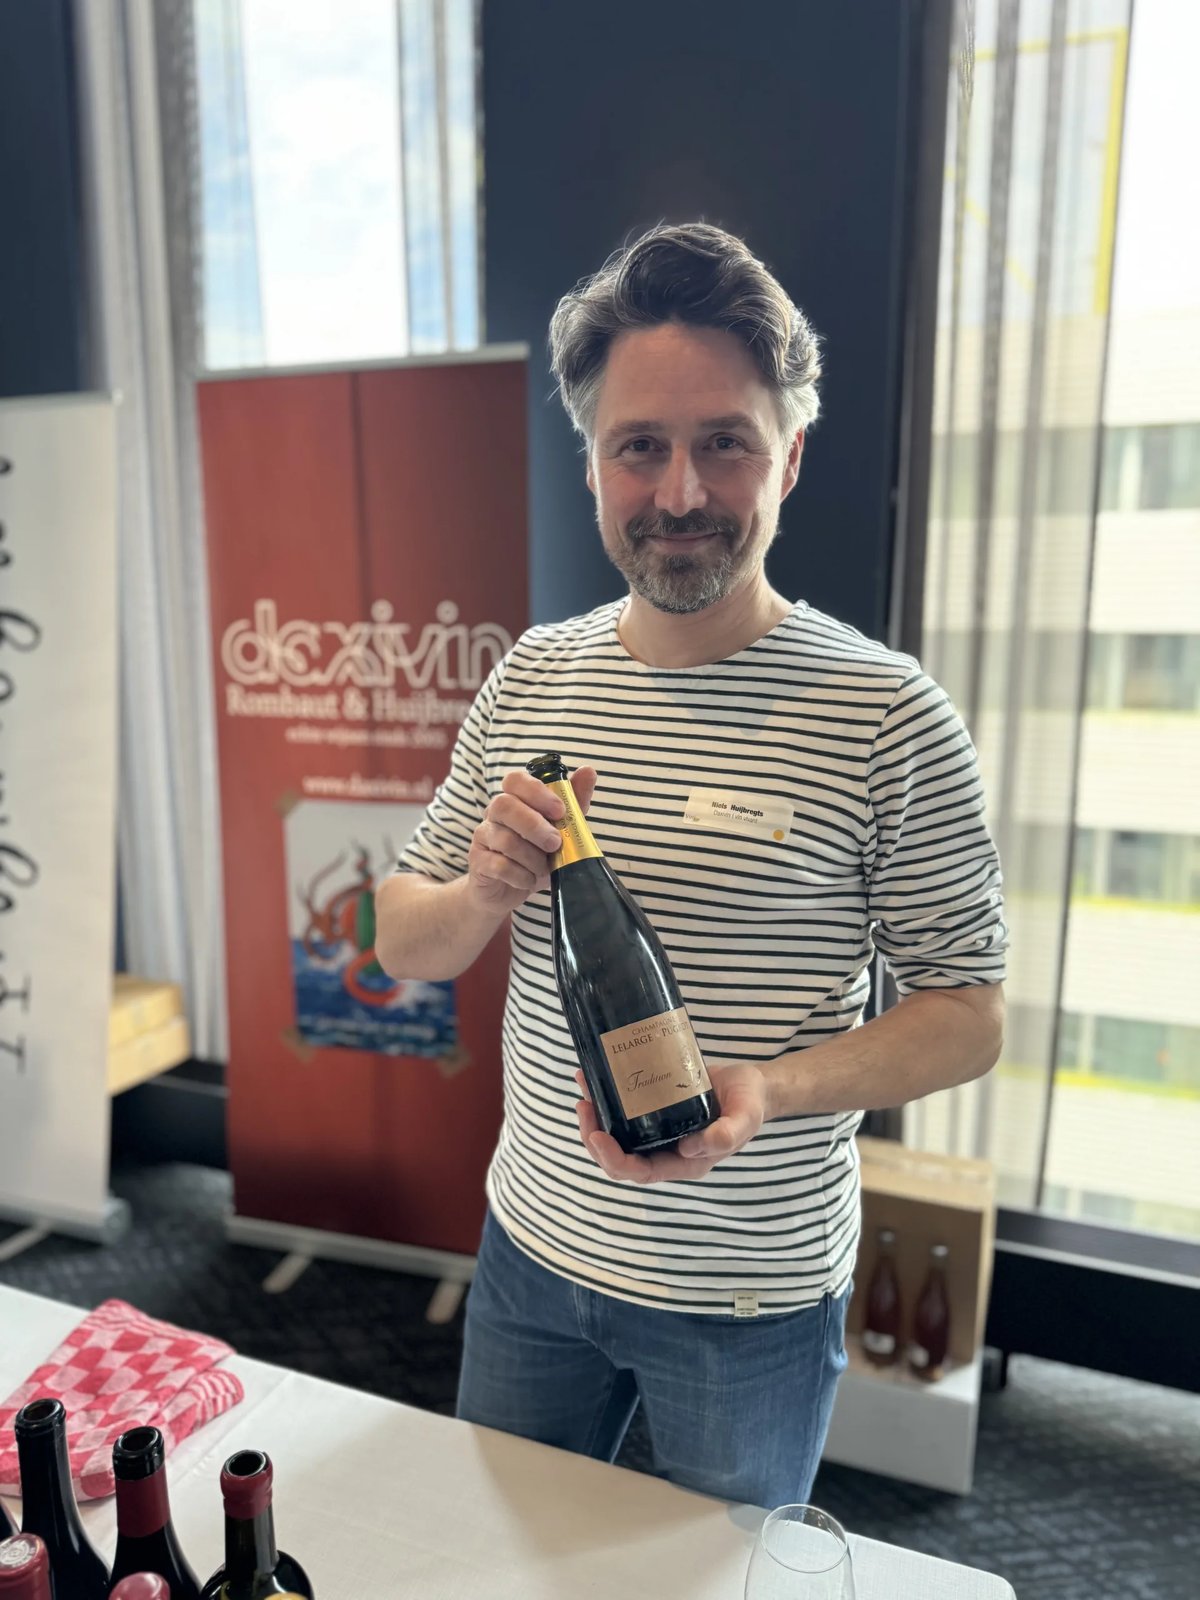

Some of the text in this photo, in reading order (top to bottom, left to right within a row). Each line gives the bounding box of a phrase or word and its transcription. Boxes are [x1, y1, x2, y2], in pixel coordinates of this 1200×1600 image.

[221, 599, 514, 690] dexivin
[344, 688, 370, 719] &
[373, 689, 472, 729] Huijbre
[711, 801, 763, 817] Niels Huijbregts
[632, 1016, 678, 1035] CHAMPAGNE
[611, 1033, 654, 1054] LELARGE
[627, 1069, 672, 1092] Tradition
